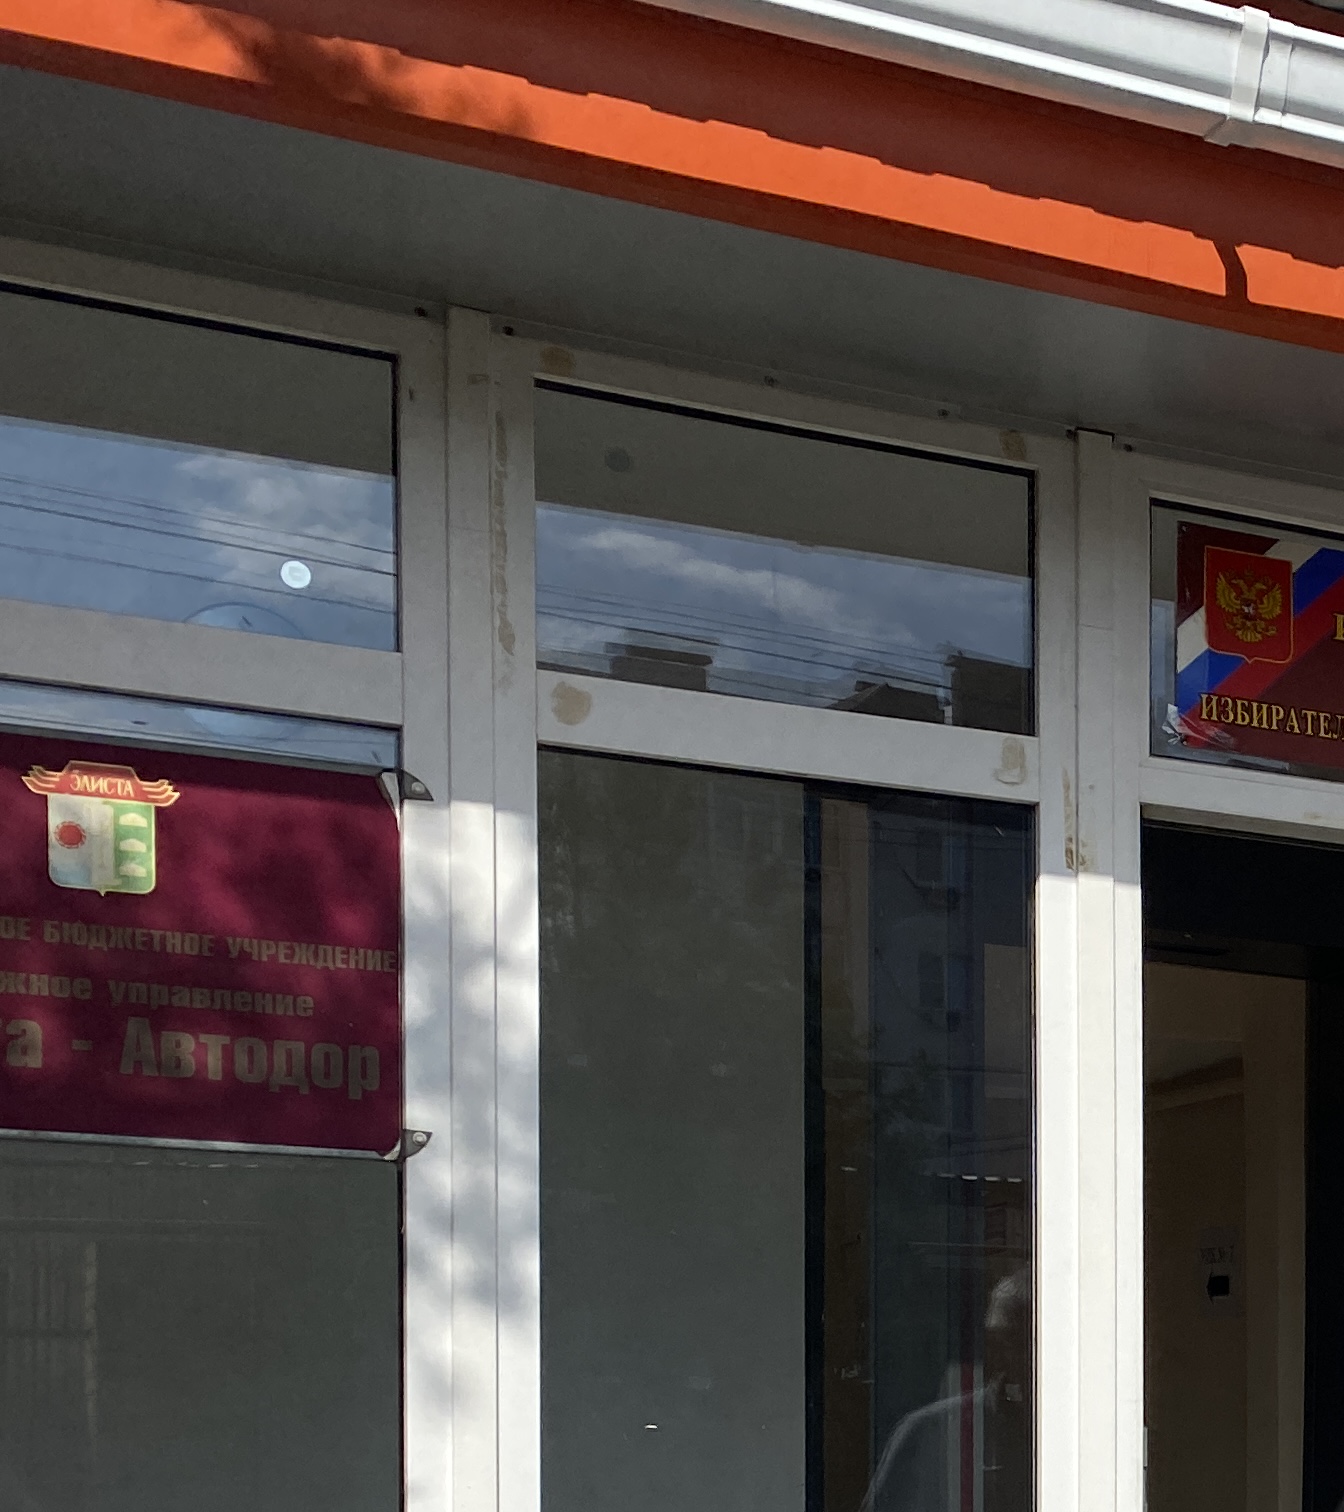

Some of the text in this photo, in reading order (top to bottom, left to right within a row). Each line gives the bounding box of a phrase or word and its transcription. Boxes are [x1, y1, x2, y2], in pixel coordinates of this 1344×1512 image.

[70, 774, 134, 797] ЭЛИСТА
[42, 919, 215, 956] БЮДЖЕТНОЕ
[226, 936, 396, 973] УЧРЕЖДЕНИЕ
[108, 979, 314, 1017] управление
[120, 1016, 380, 1100] Автодор
